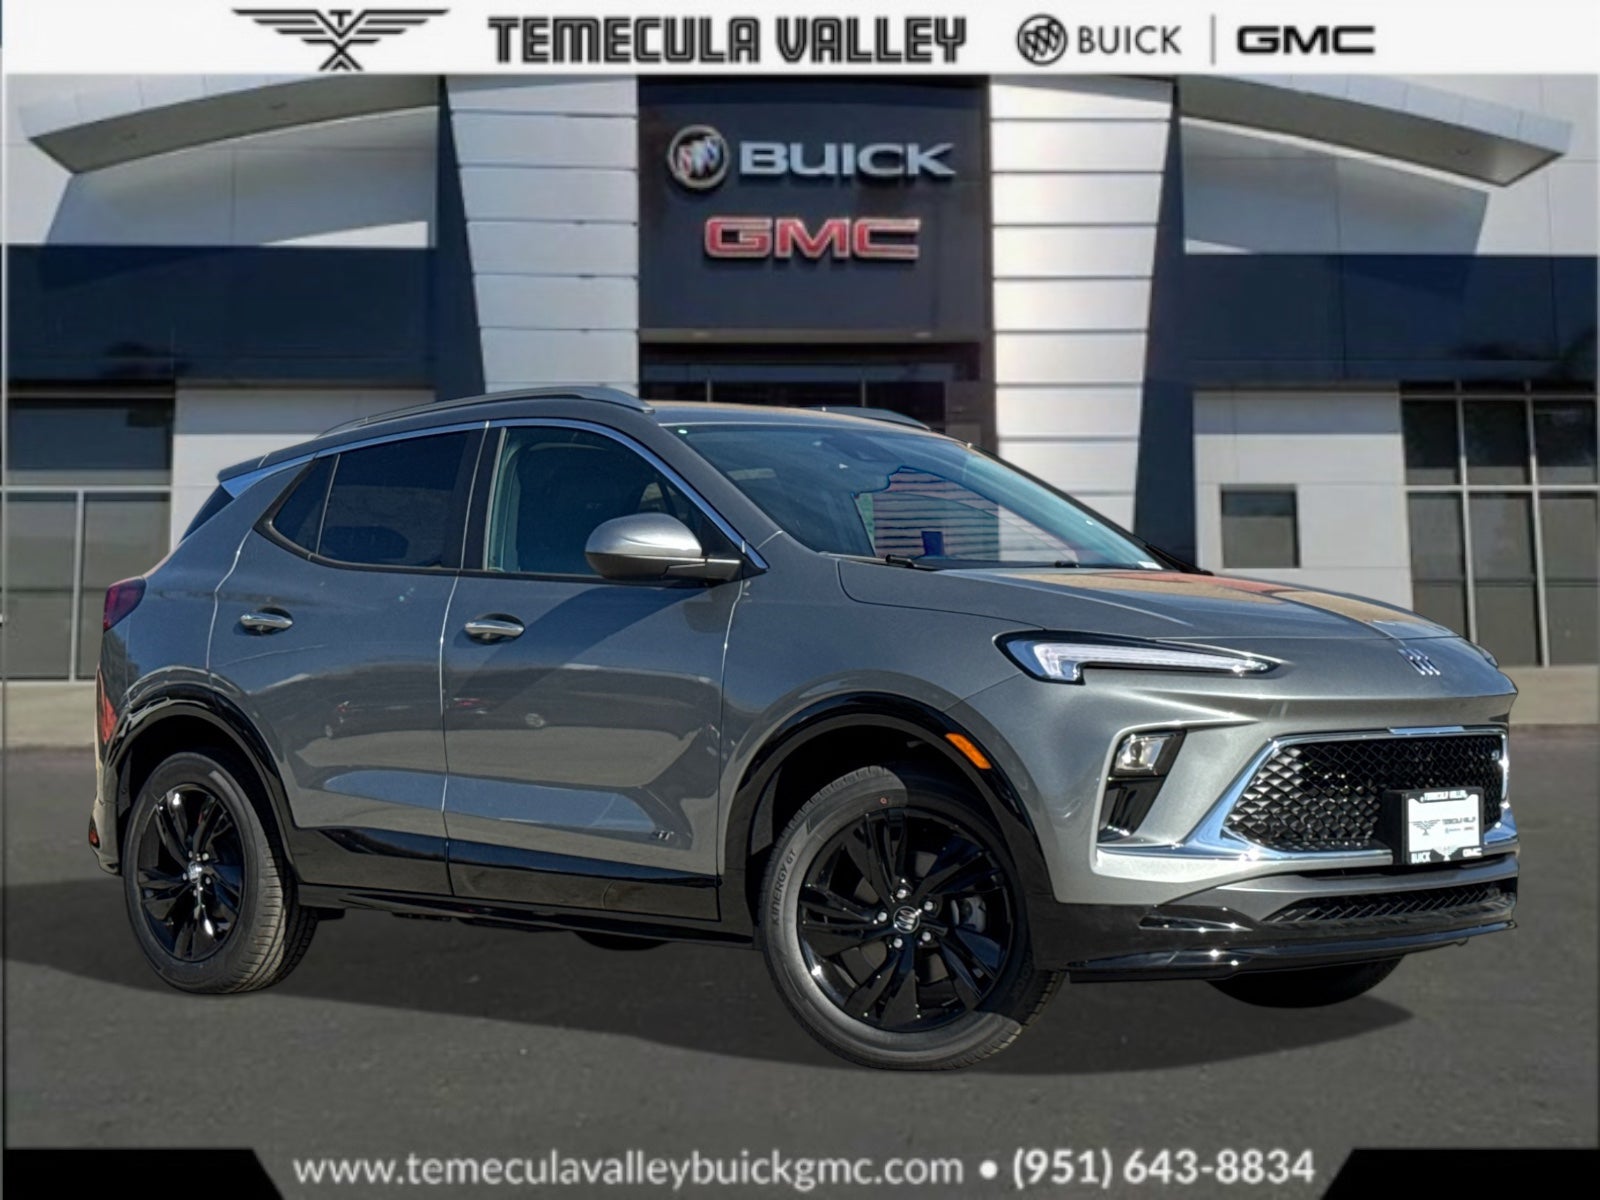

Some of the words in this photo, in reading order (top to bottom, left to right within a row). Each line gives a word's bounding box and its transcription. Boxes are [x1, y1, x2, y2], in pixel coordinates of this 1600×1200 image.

[739, 141, 957, 176] BUICK
[704, 216, 921, 260] GMC
[786, 849, 797, 865] GT
